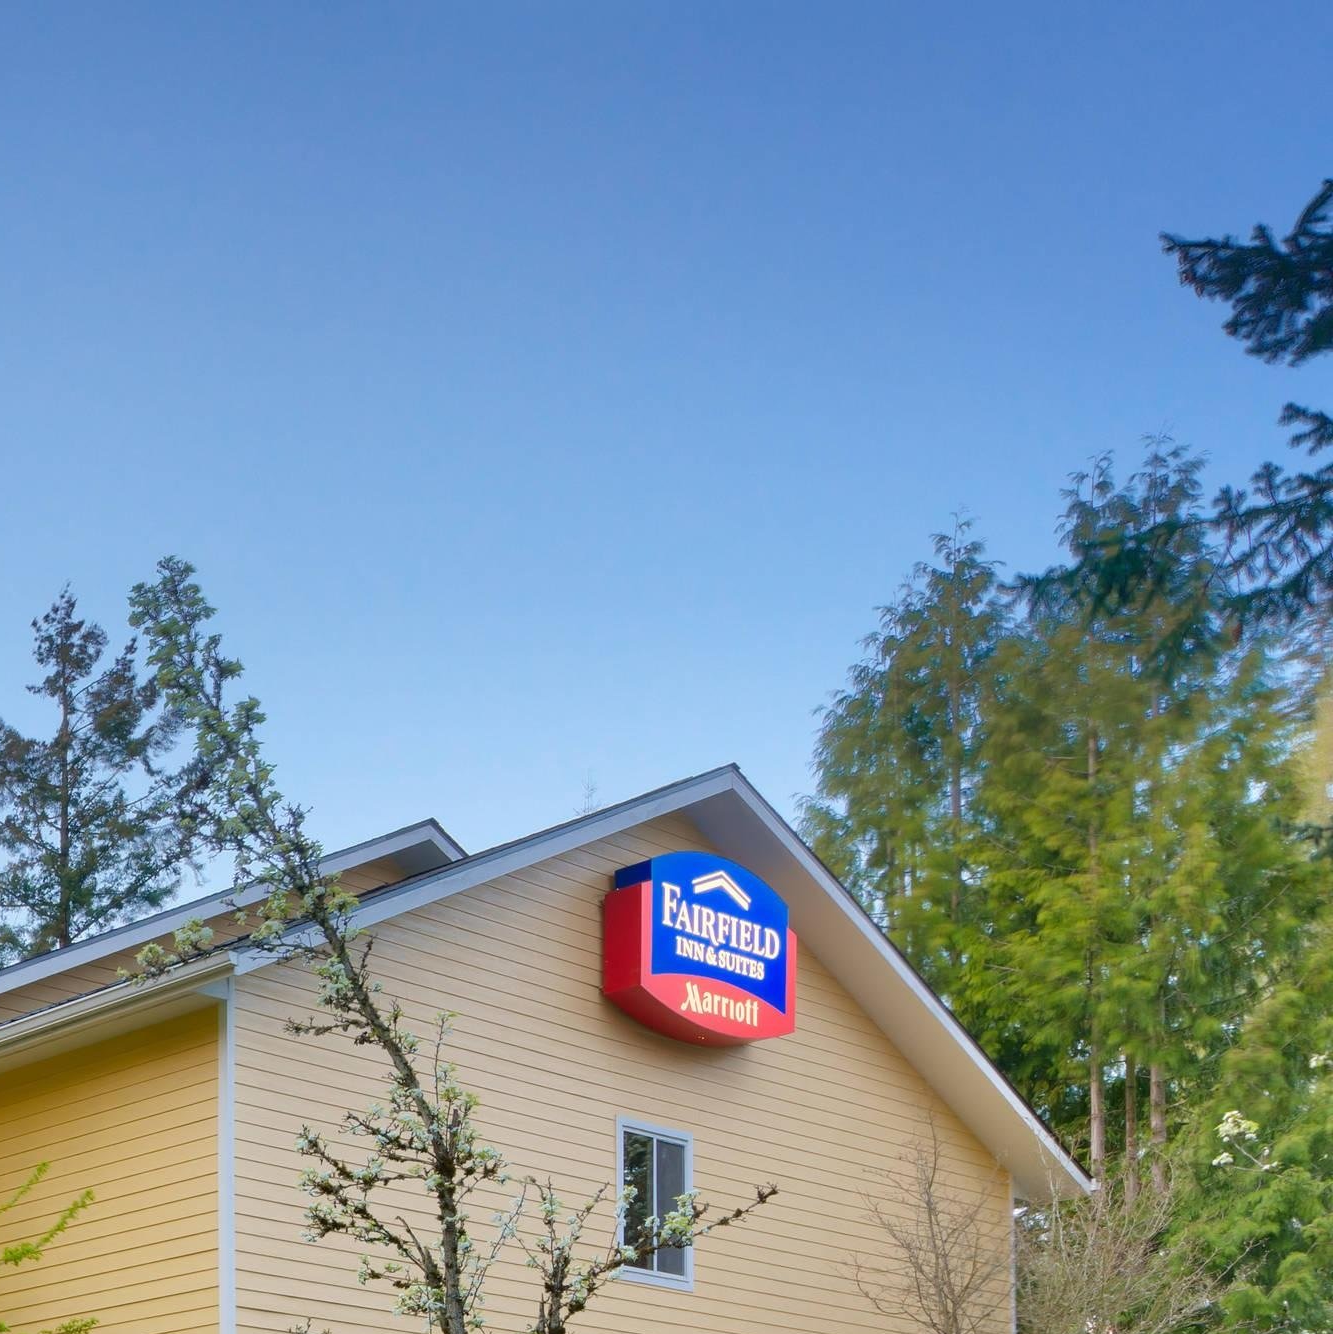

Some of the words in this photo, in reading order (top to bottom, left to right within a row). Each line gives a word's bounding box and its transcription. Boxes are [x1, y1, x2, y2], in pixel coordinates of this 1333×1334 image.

[661, 882, 779, 959] FAIRFIELD
[676, 936, 705, 962] INN
[706, 949, 717, 966] &
[718, 950, 765, 980] SUITES
[681, 982, 759, 1026] Marriott
